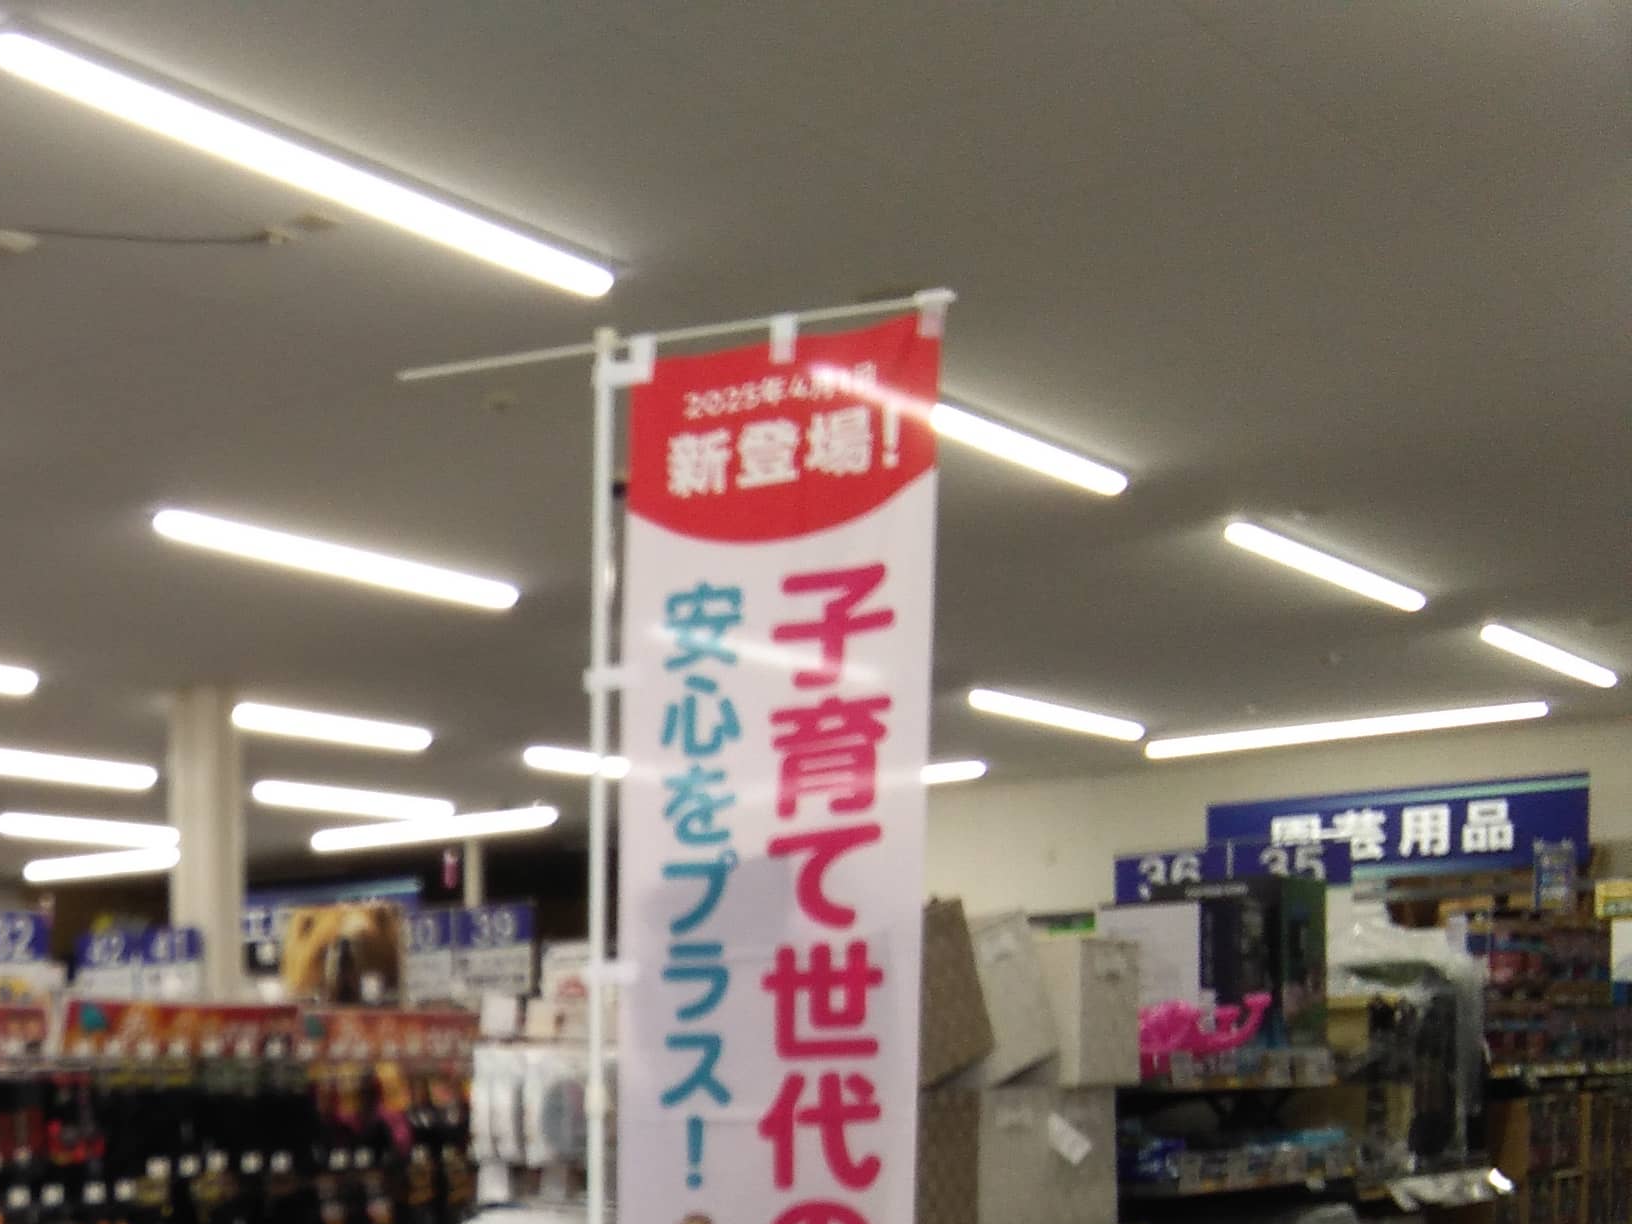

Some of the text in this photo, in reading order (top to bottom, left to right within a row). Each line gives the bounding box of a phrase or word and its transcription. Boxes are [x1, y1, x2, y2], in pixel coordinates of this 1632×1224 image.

[667, 402, 901, 499] 新登場!
[659, 582, 744, 1191] 安心をプラス!
